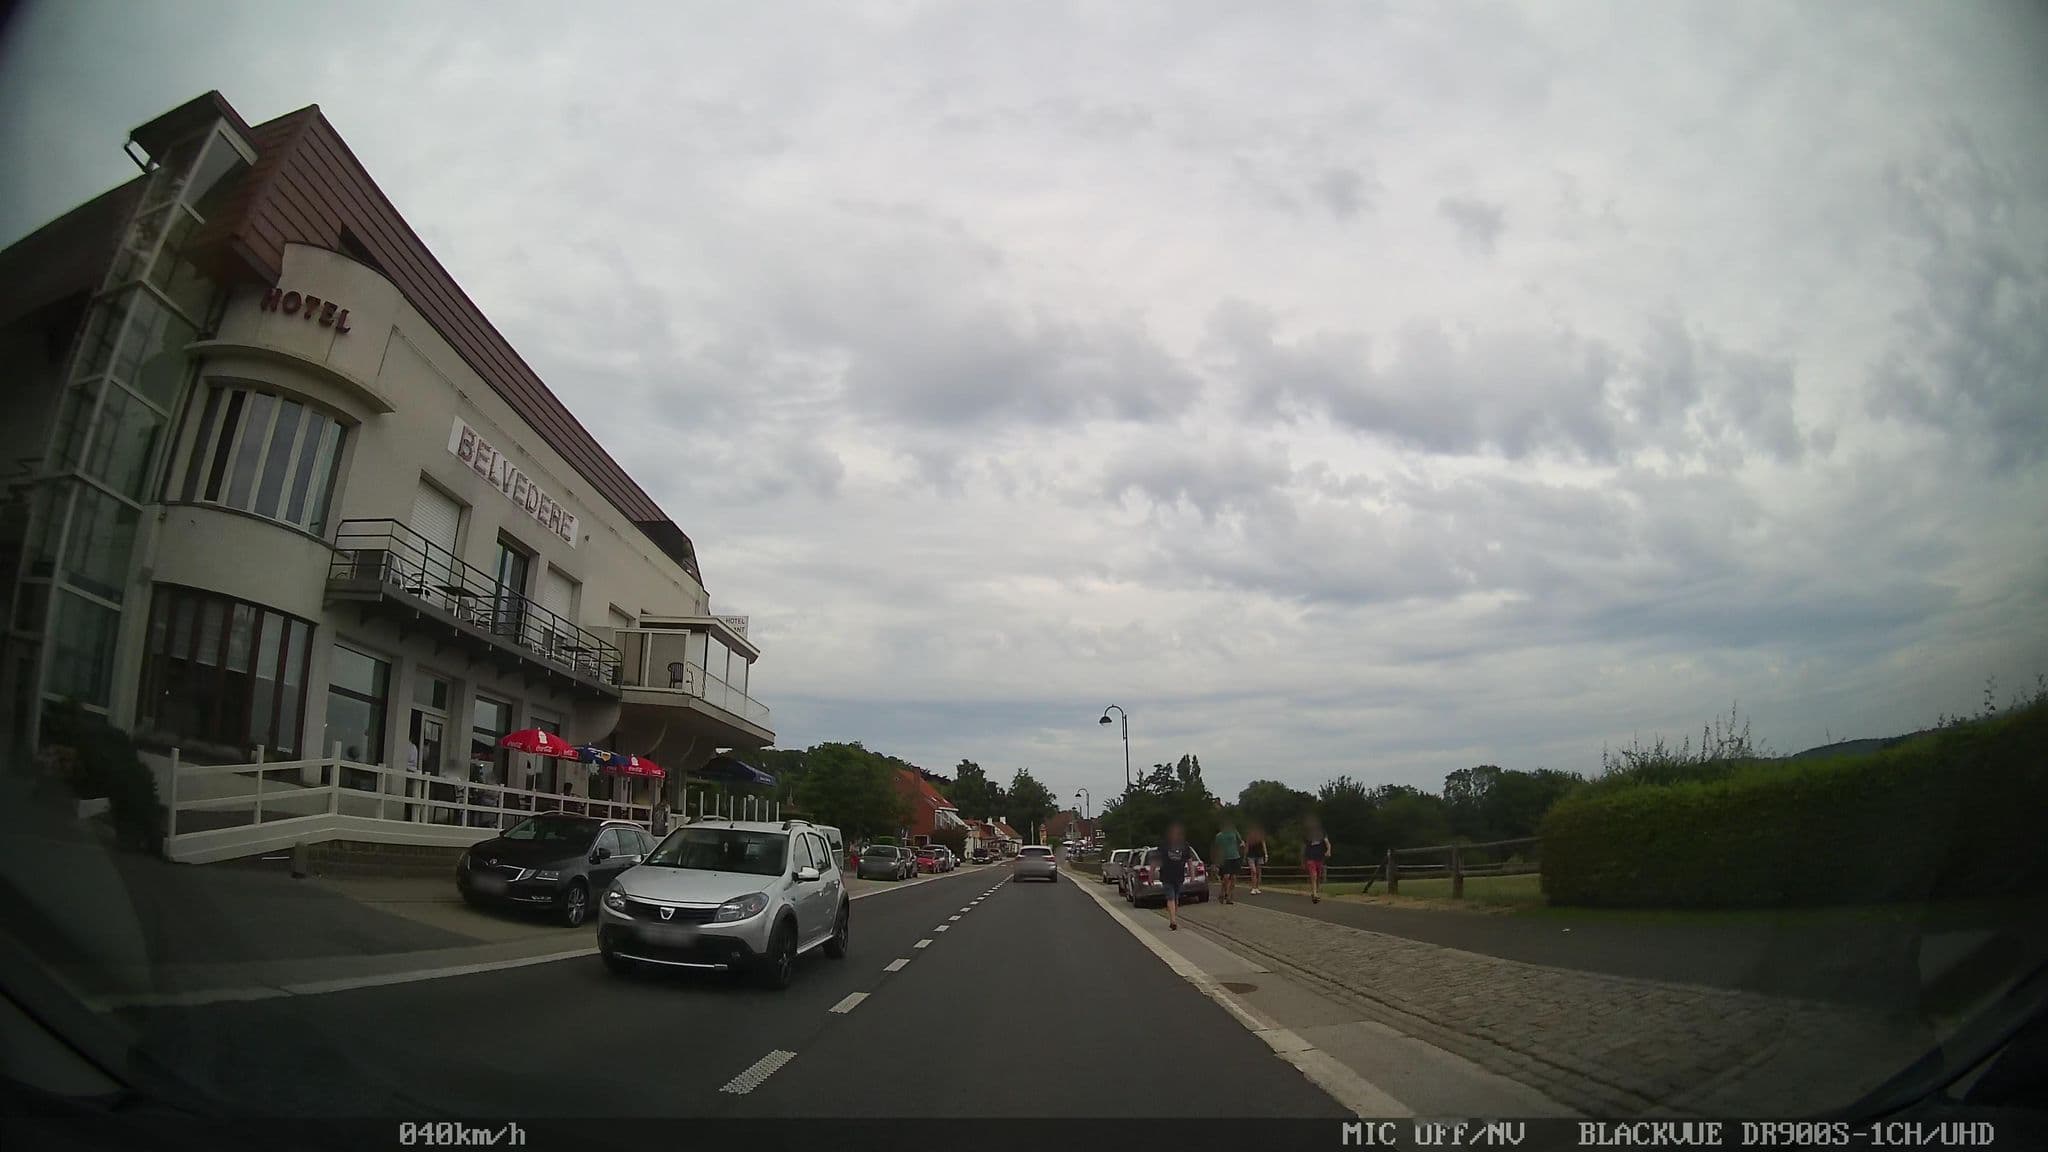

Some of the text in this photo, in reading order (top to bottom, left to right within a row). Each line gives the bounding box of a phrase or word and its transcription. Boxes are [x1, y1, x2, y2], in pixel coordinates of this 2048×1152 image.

[261, 288, 351, 333] HOTEL
[458, 425, 574, 542] BELVEDERE
[725, 617, 745, 625] HOTEL
